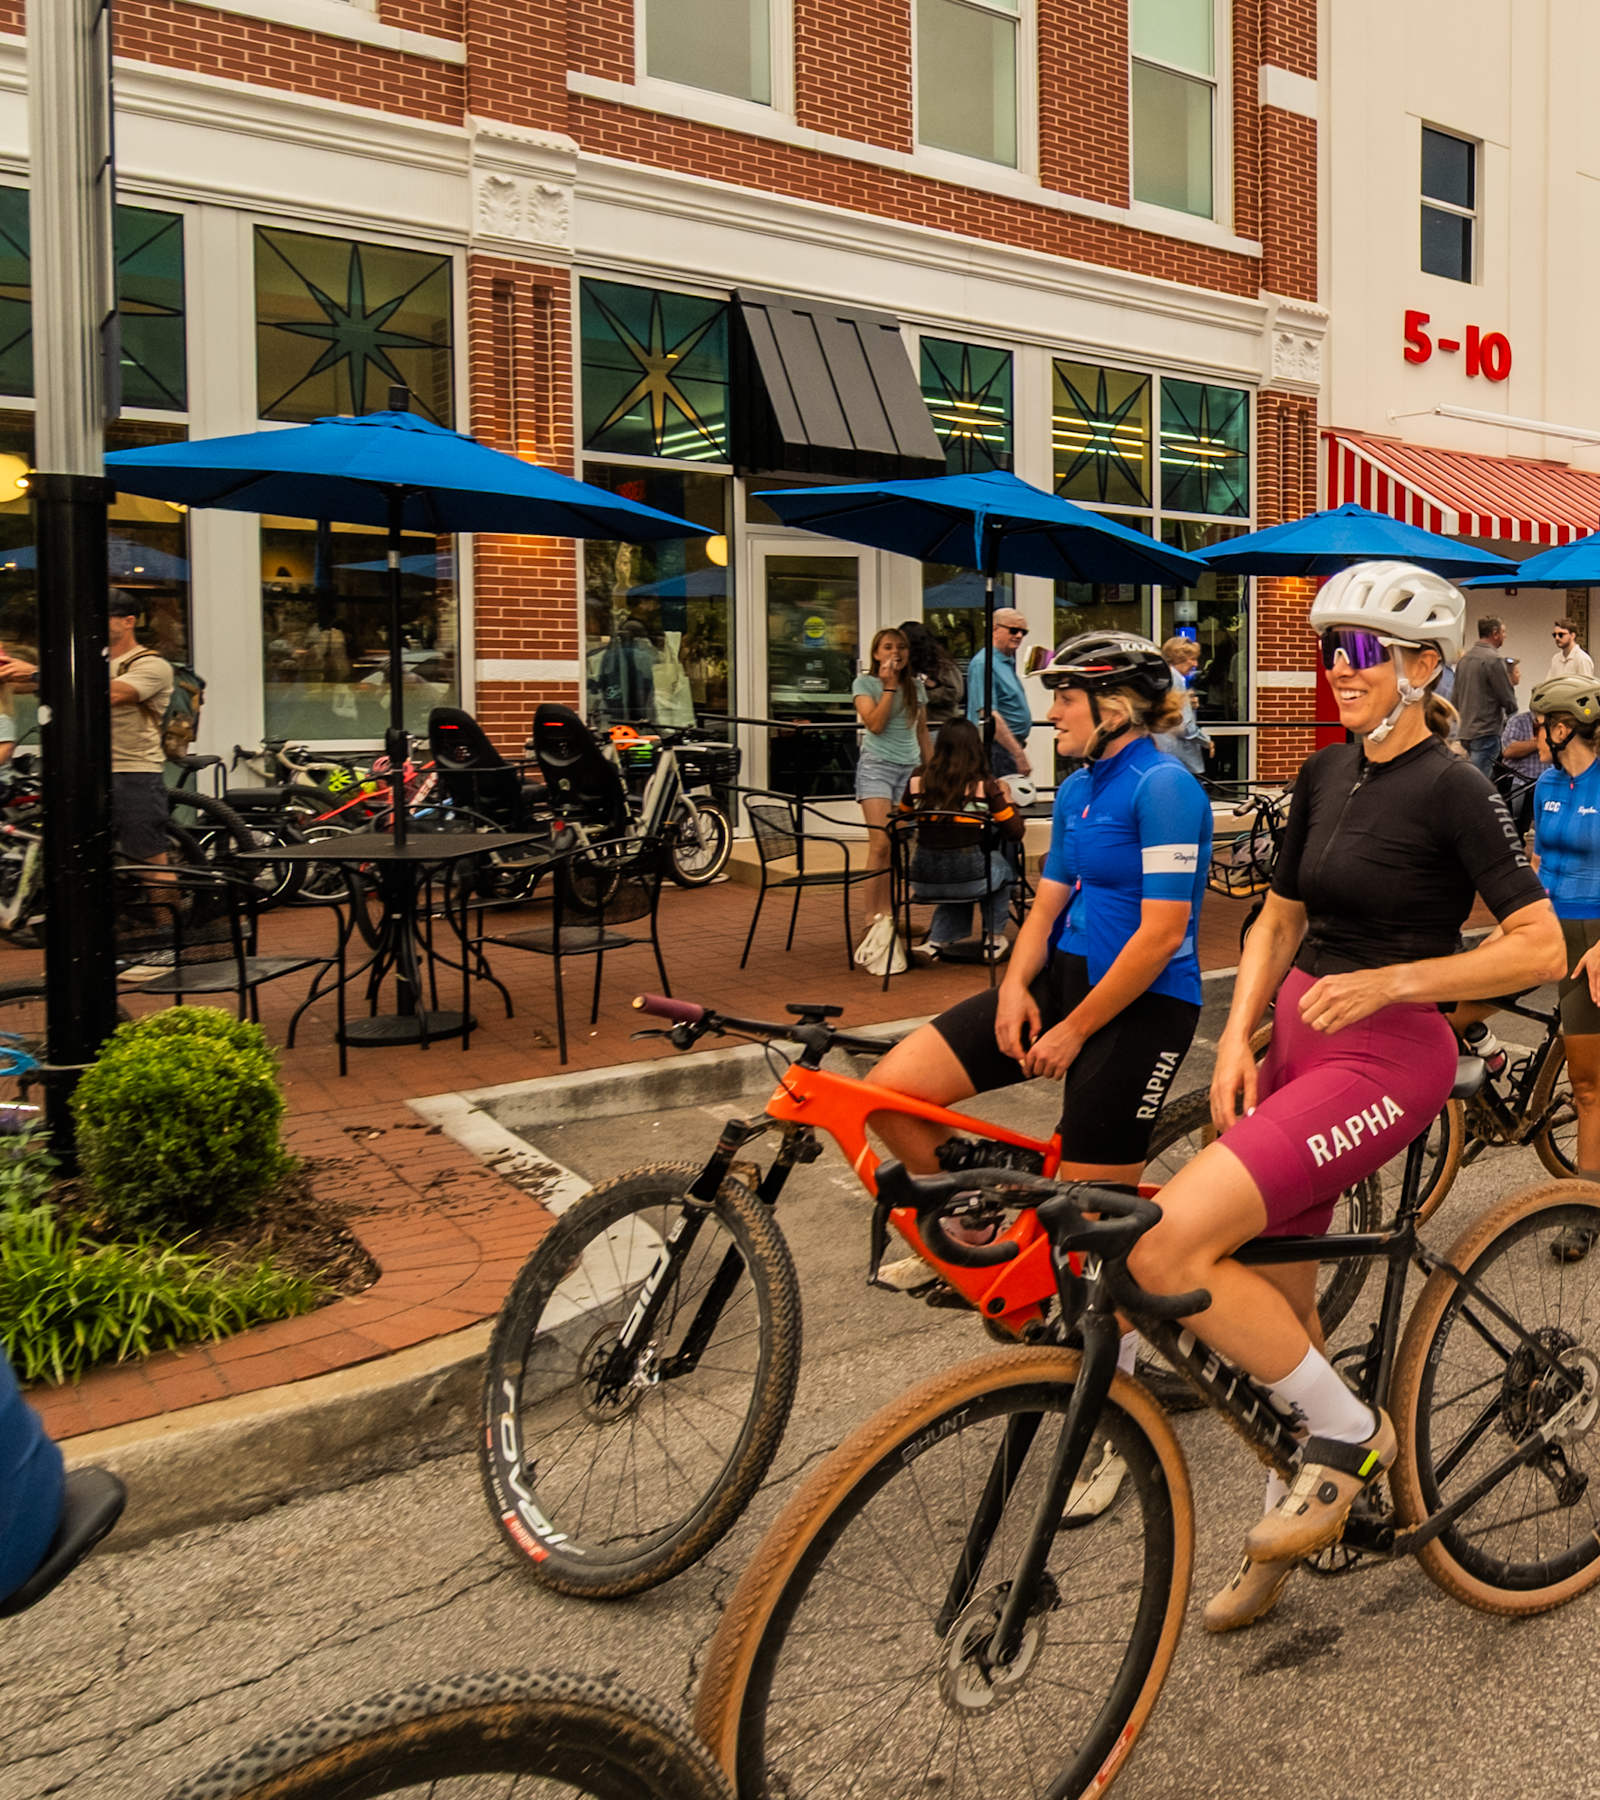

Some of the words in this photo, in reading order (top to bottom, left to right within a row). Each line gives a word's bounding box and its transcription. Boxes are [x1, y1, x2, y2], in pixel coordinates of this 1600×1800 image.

[1403, 309, 1512, 382] 5-10
[1136, 1051, 1180, 1119] RAPHA
[1306, 1095, 1405, 1168] RAPHA
[917, 1407, 971, 1449] HUNT
